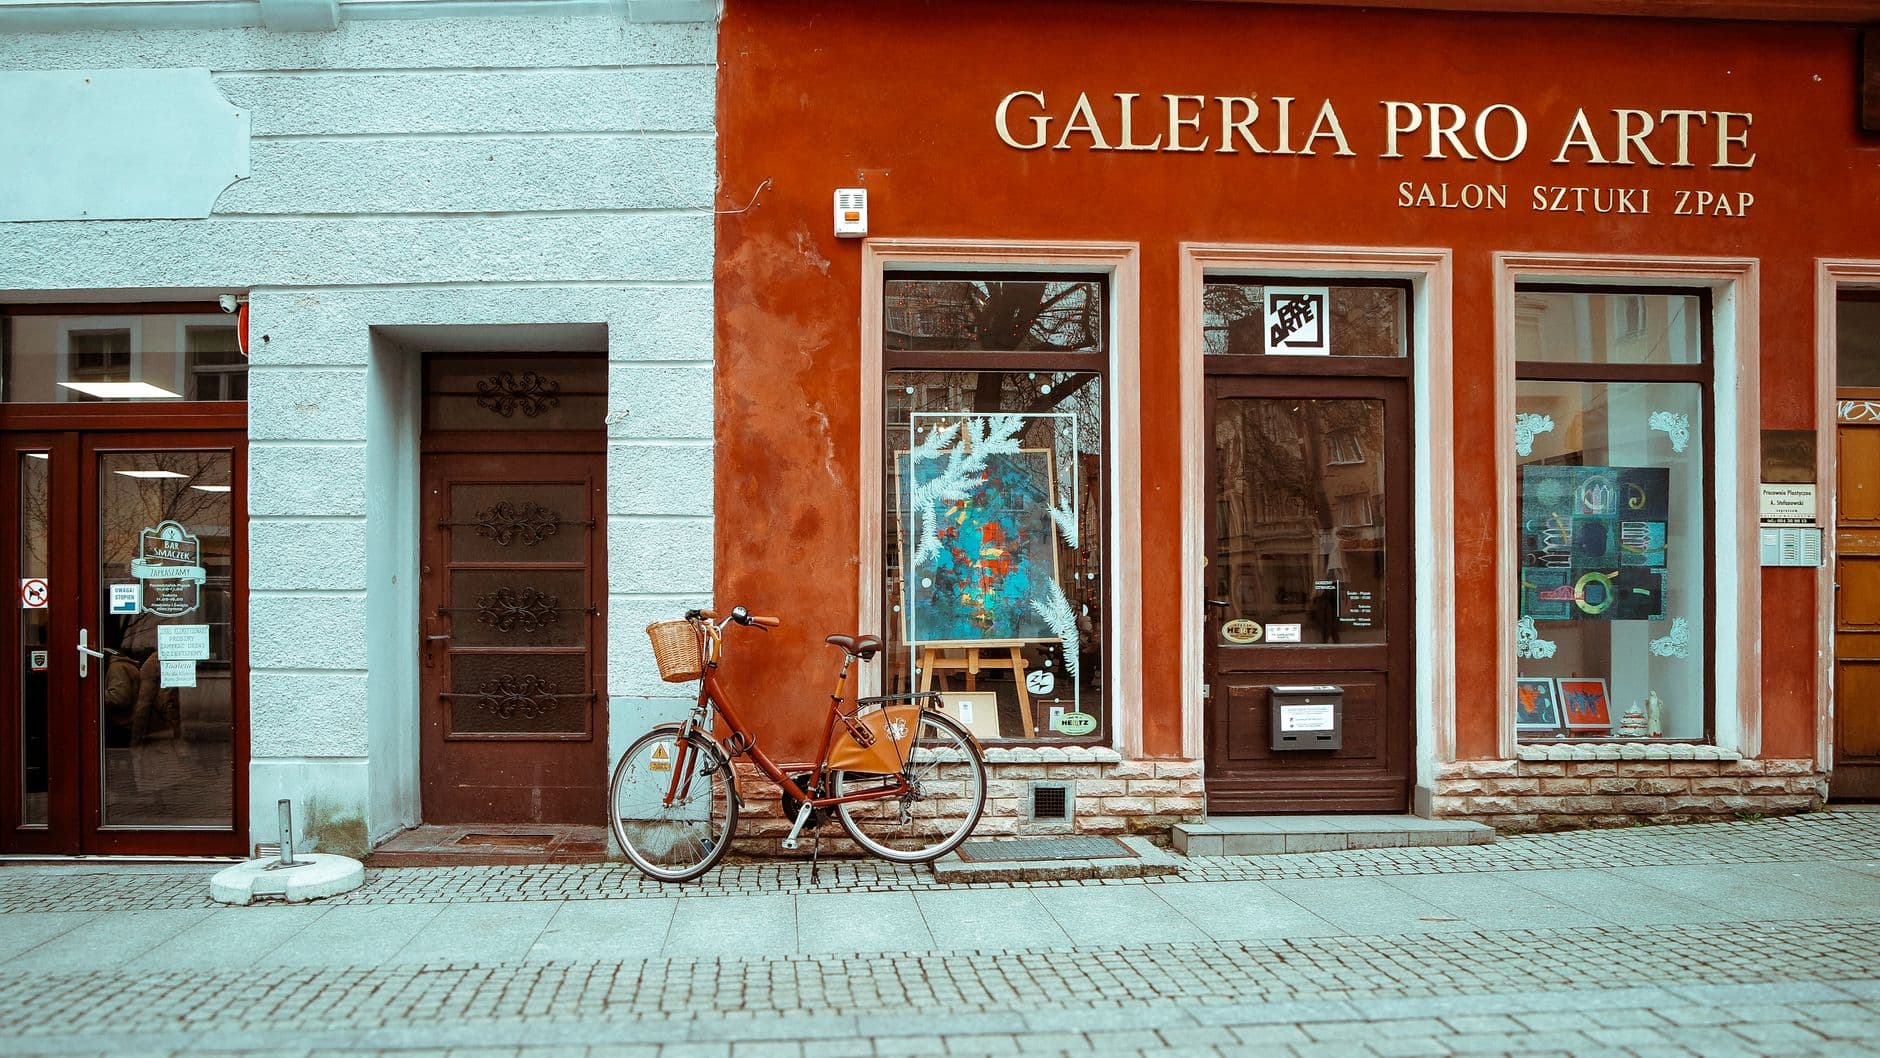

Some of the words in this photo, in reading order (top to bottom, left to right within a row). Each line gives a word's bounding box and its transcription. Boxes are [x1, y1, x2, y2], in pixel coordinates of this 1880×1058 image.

[994, 90, 1357, 157] GALERIA
[1380, 100, 1528, 163] PRO
[1551, 107, 1757, 168] ARTE
[1398, 181, 1507, 210] SALON
[1532, 185, 1651, 215] SZTUKI
[1673, 189, 1755, 218] ZPAP
[153, 547, 190, 561] SMACZEK
[164, 540, 179, 550] BAR
